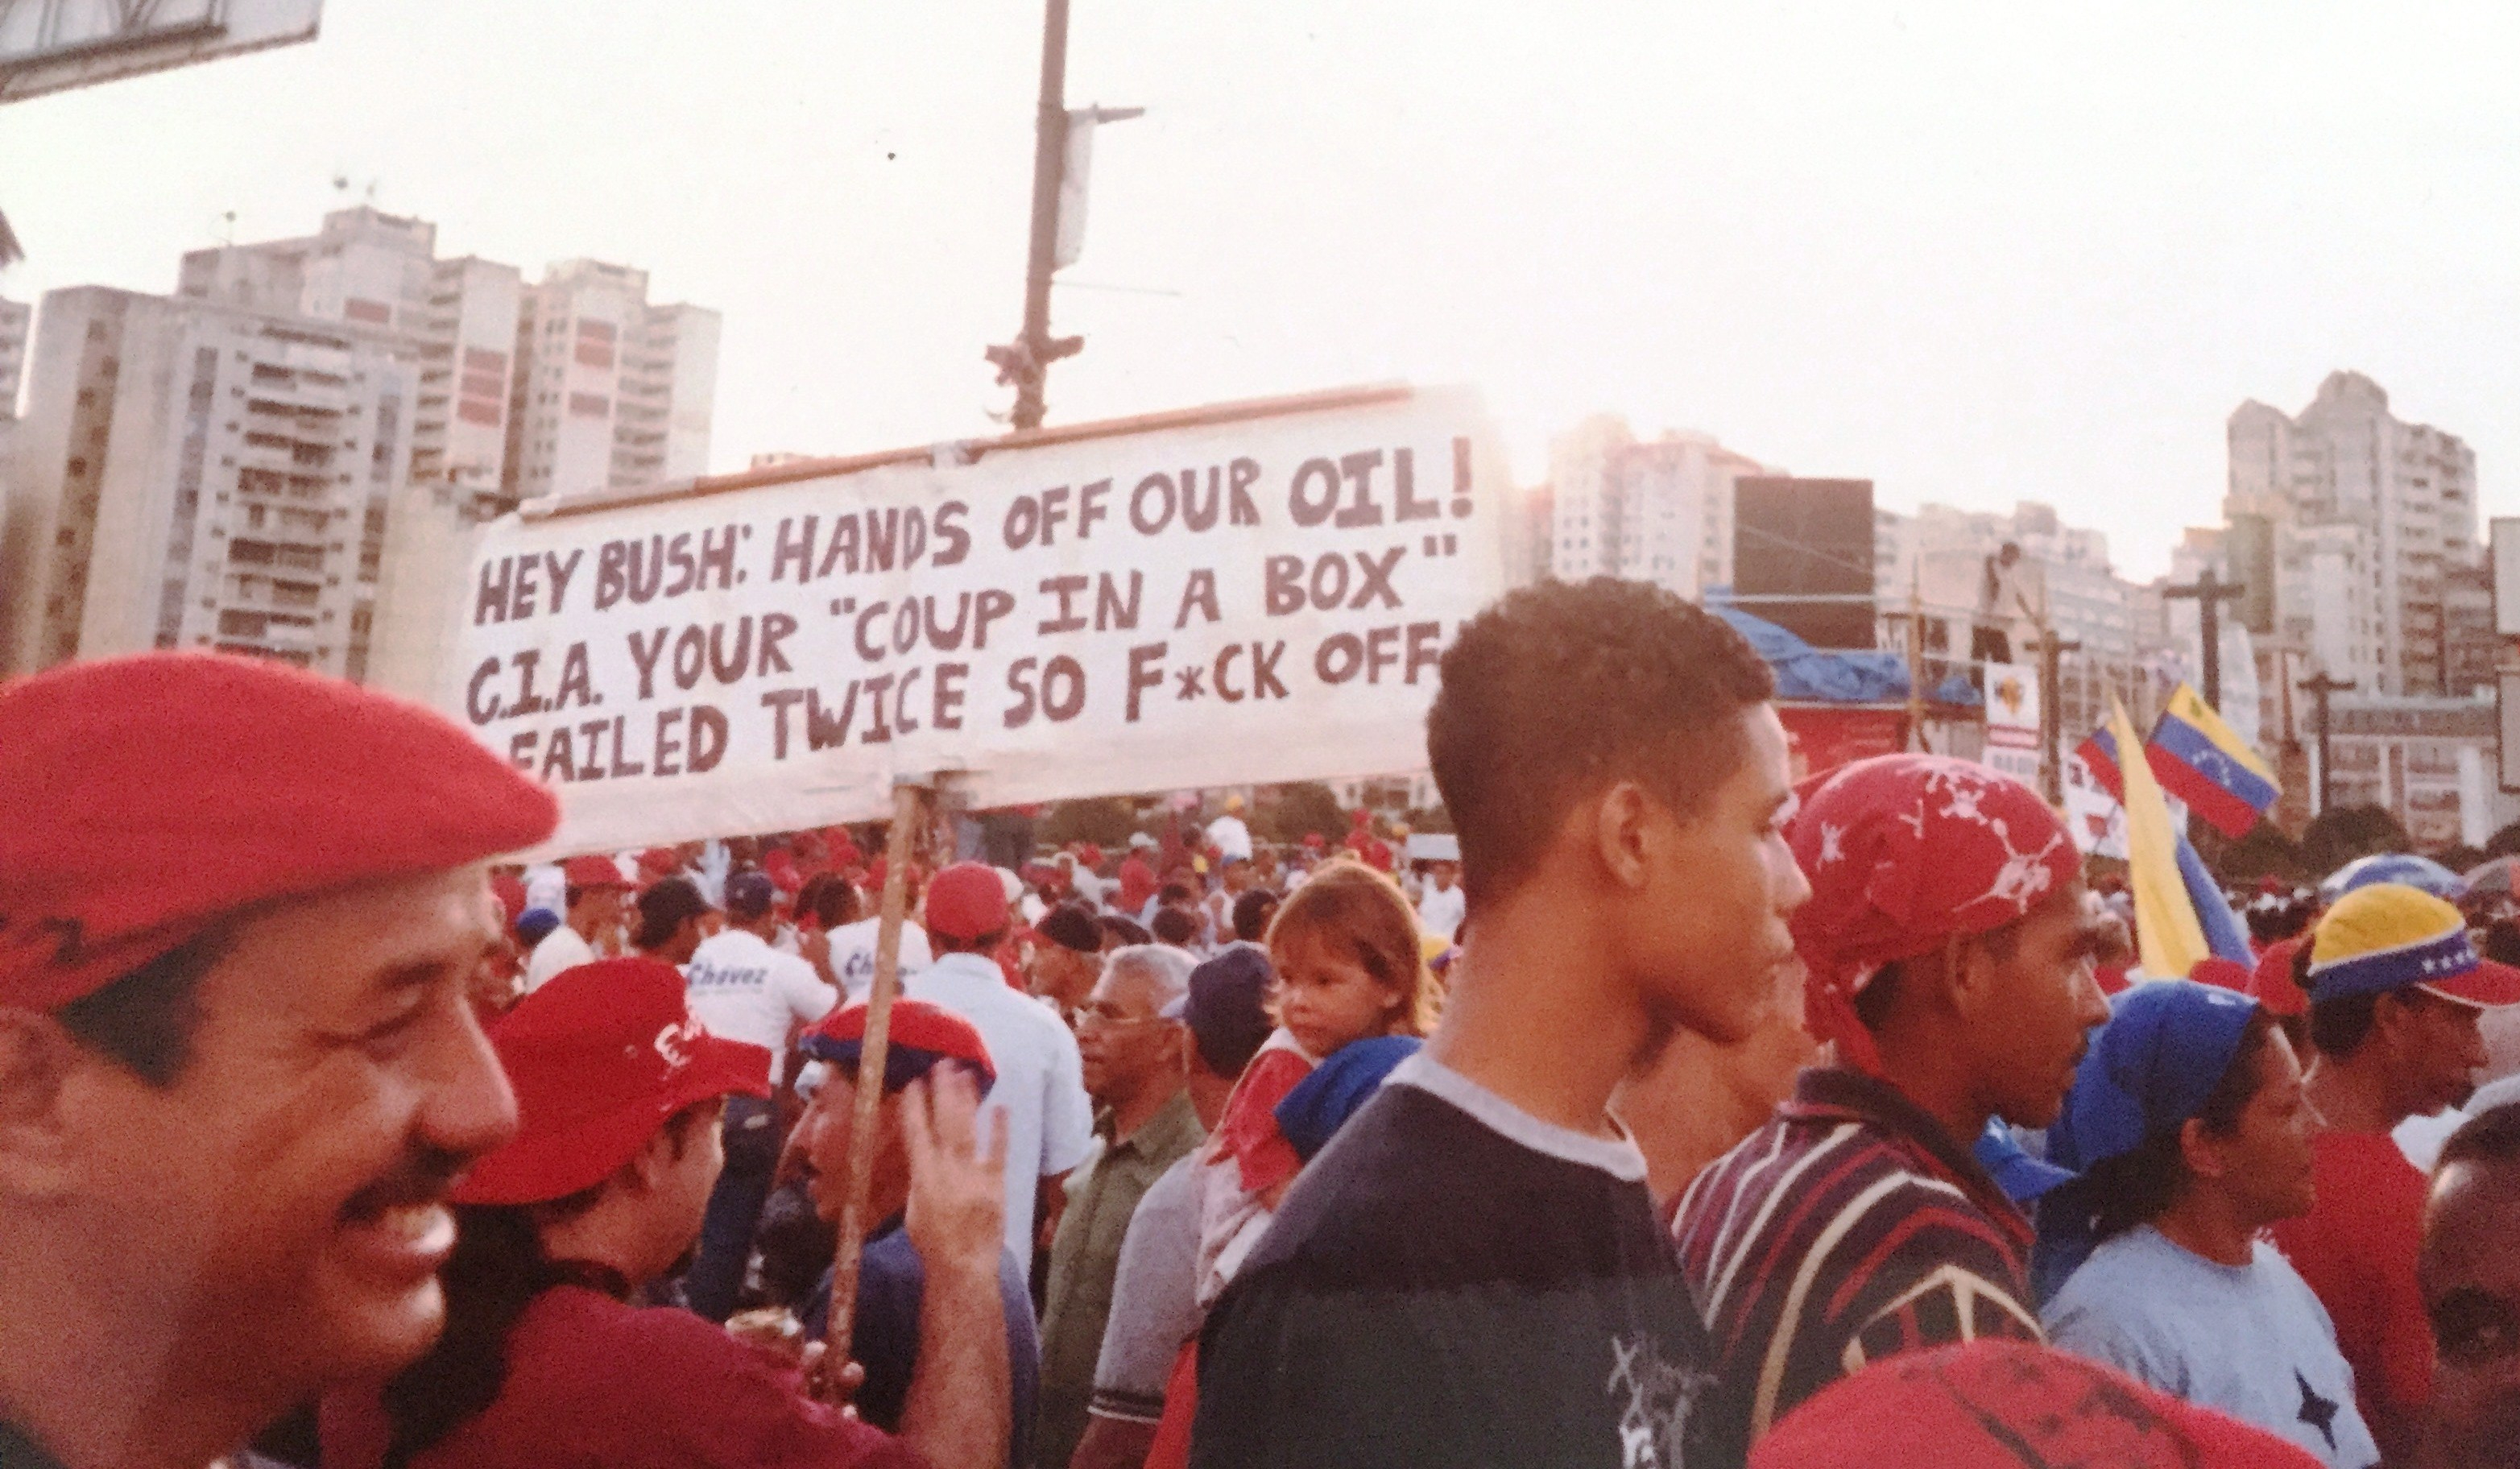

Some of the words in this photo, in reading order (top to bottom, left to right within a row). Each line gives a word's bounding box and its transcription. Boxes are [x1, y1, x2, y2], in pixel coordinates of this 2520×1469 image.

[474, 548, 583, 625] HEY
[771, 501, 971, 584] HANDS
[1003, 478, 1112, 549] OFF
[1130, 457, 1260, 536] OUR
[1289, 437, 1472, 528] OIL!
[467, 642, 602, 725] C.I.A.
[627, 612, 797, 700] YOUR
[830, 590, 1015, 661] "COUP
[1038, 569, 1143, 635] IN
[1174, 569, 1221, 629] A
[1265, 534, 1456, 617] BOX"
[509, 705, 728, 784] FAILED
[761, 664, 969, 760] TWICE
[1003, 655, 1086, 726] SO
[1315, 621, 1440, 685] OFF
